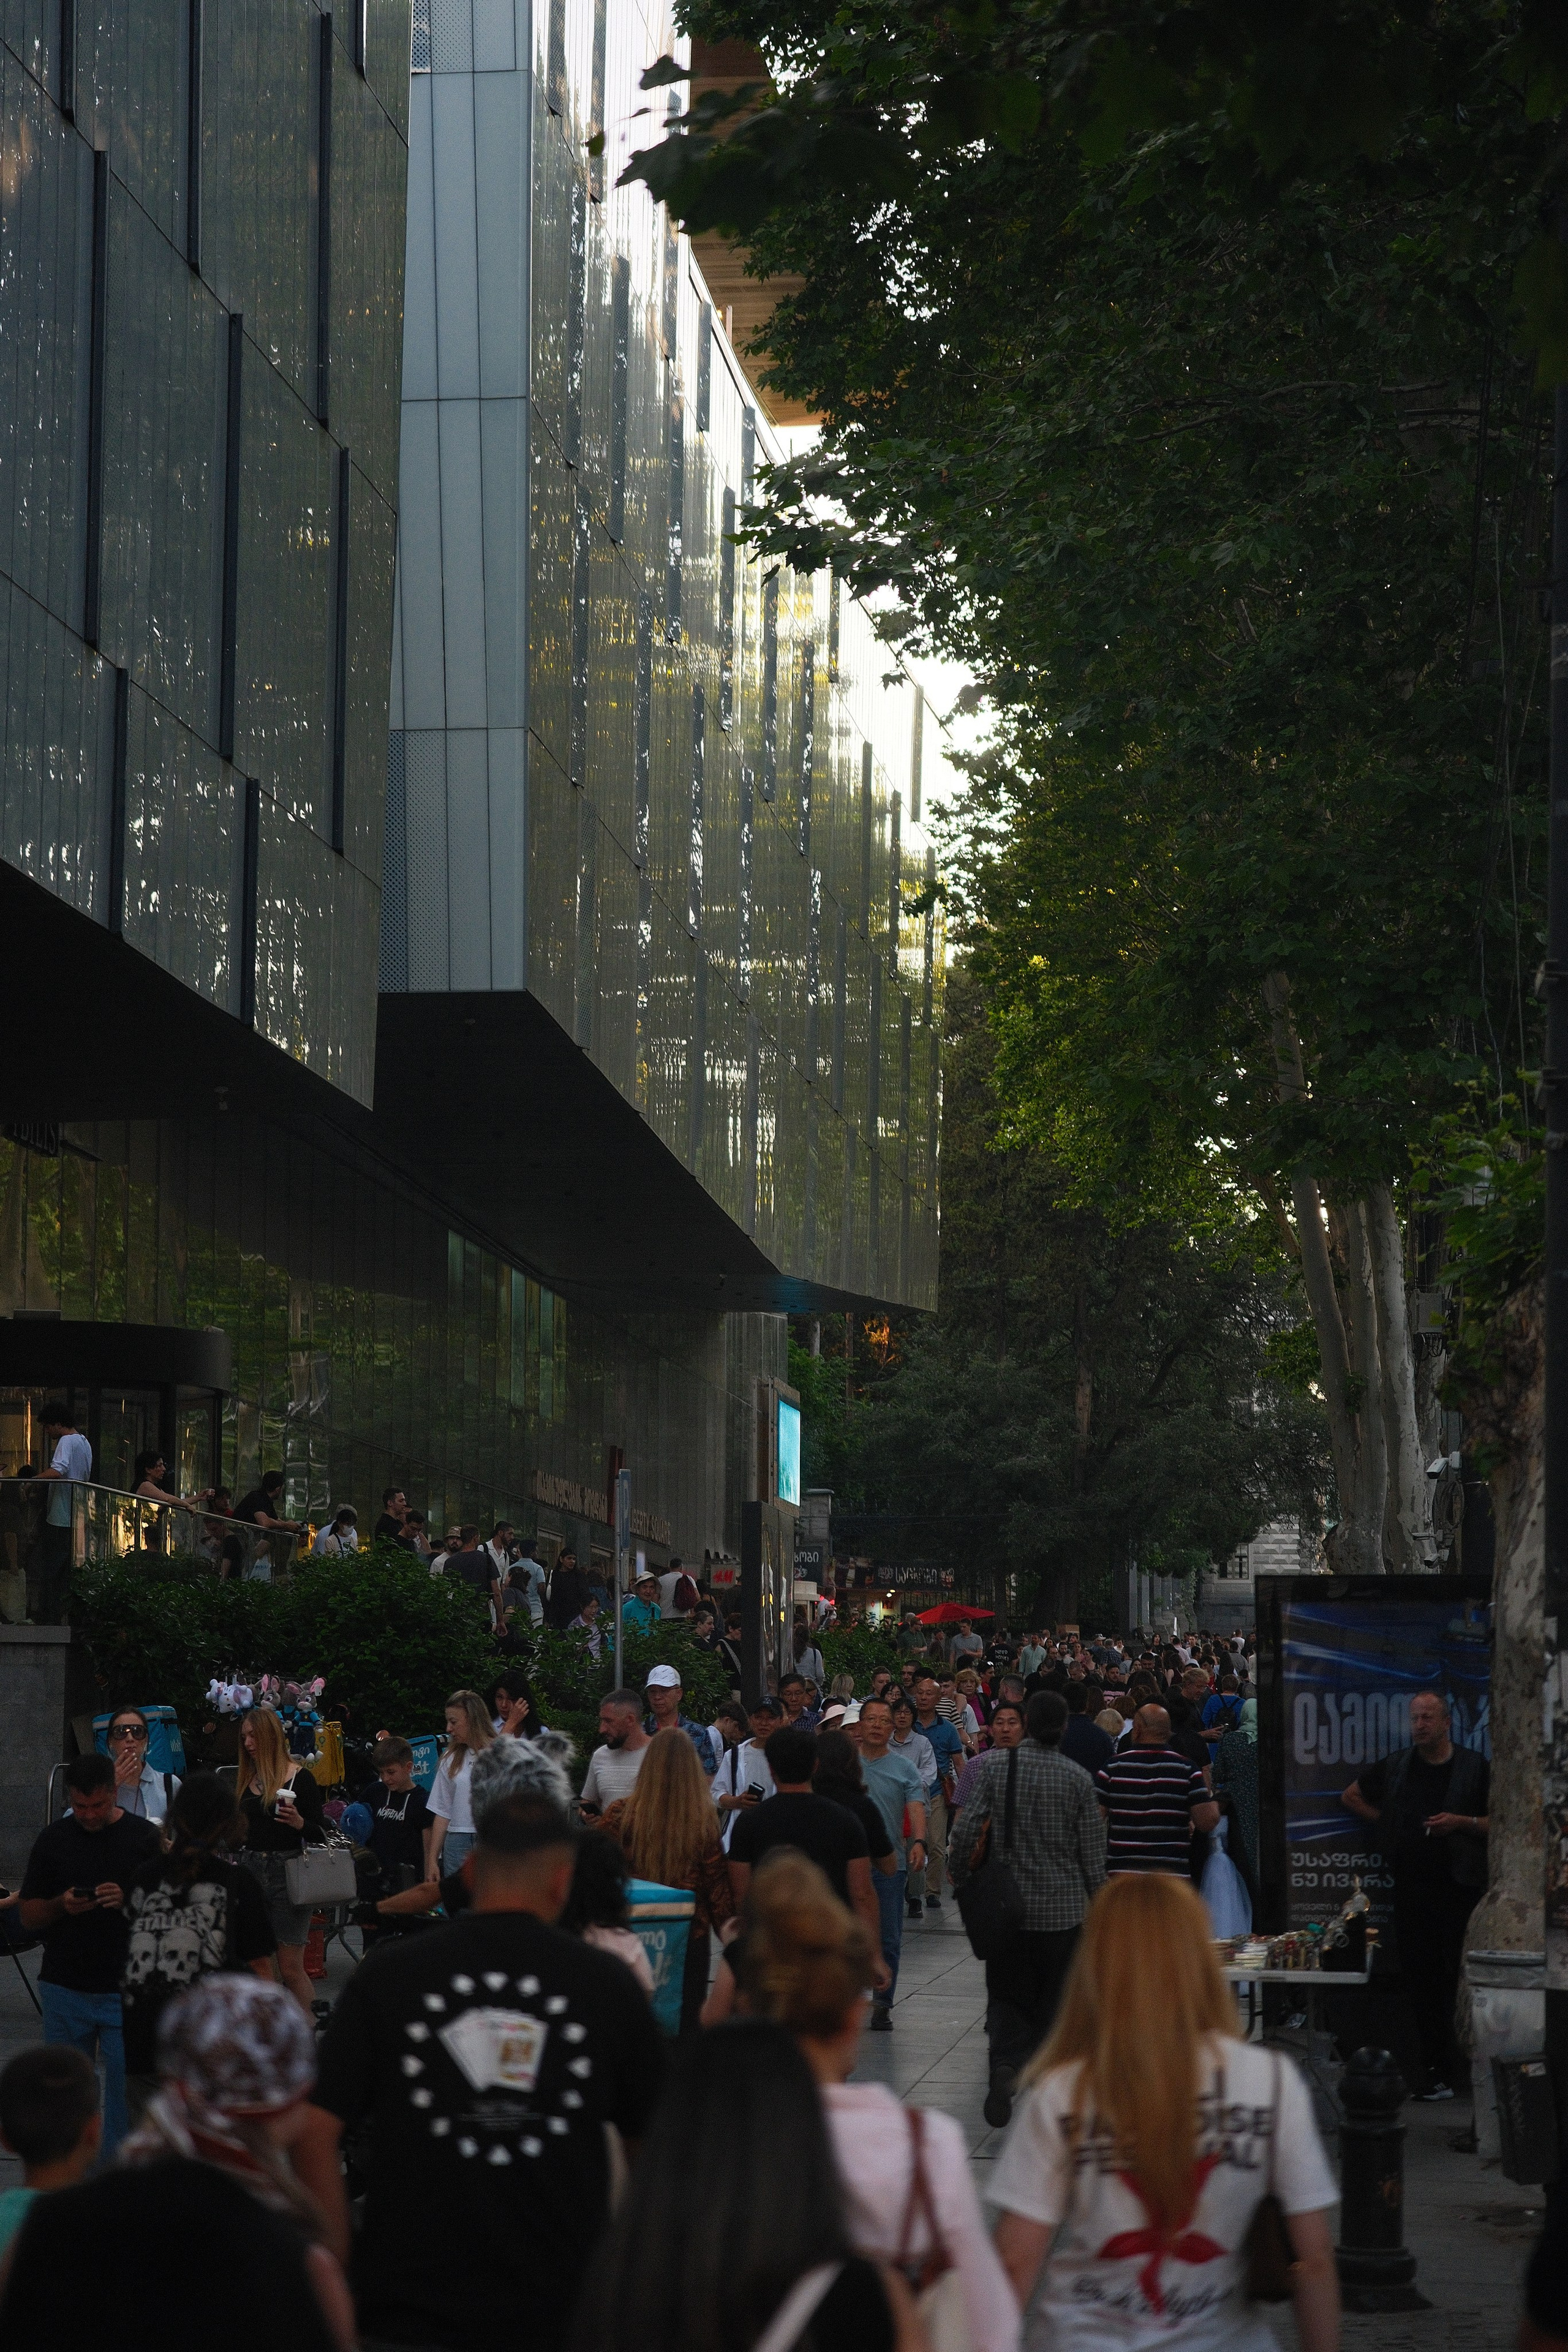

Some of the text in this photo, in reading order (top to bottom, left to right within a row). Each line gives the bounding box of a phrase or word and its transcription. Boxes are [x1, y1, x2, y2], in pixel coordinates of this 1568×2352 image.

[630, 1507, 650, 1538] IBERTY
[794, 1551, 819, 1562] ხობი
[376, 1807, 405, 1822] NOTHING
